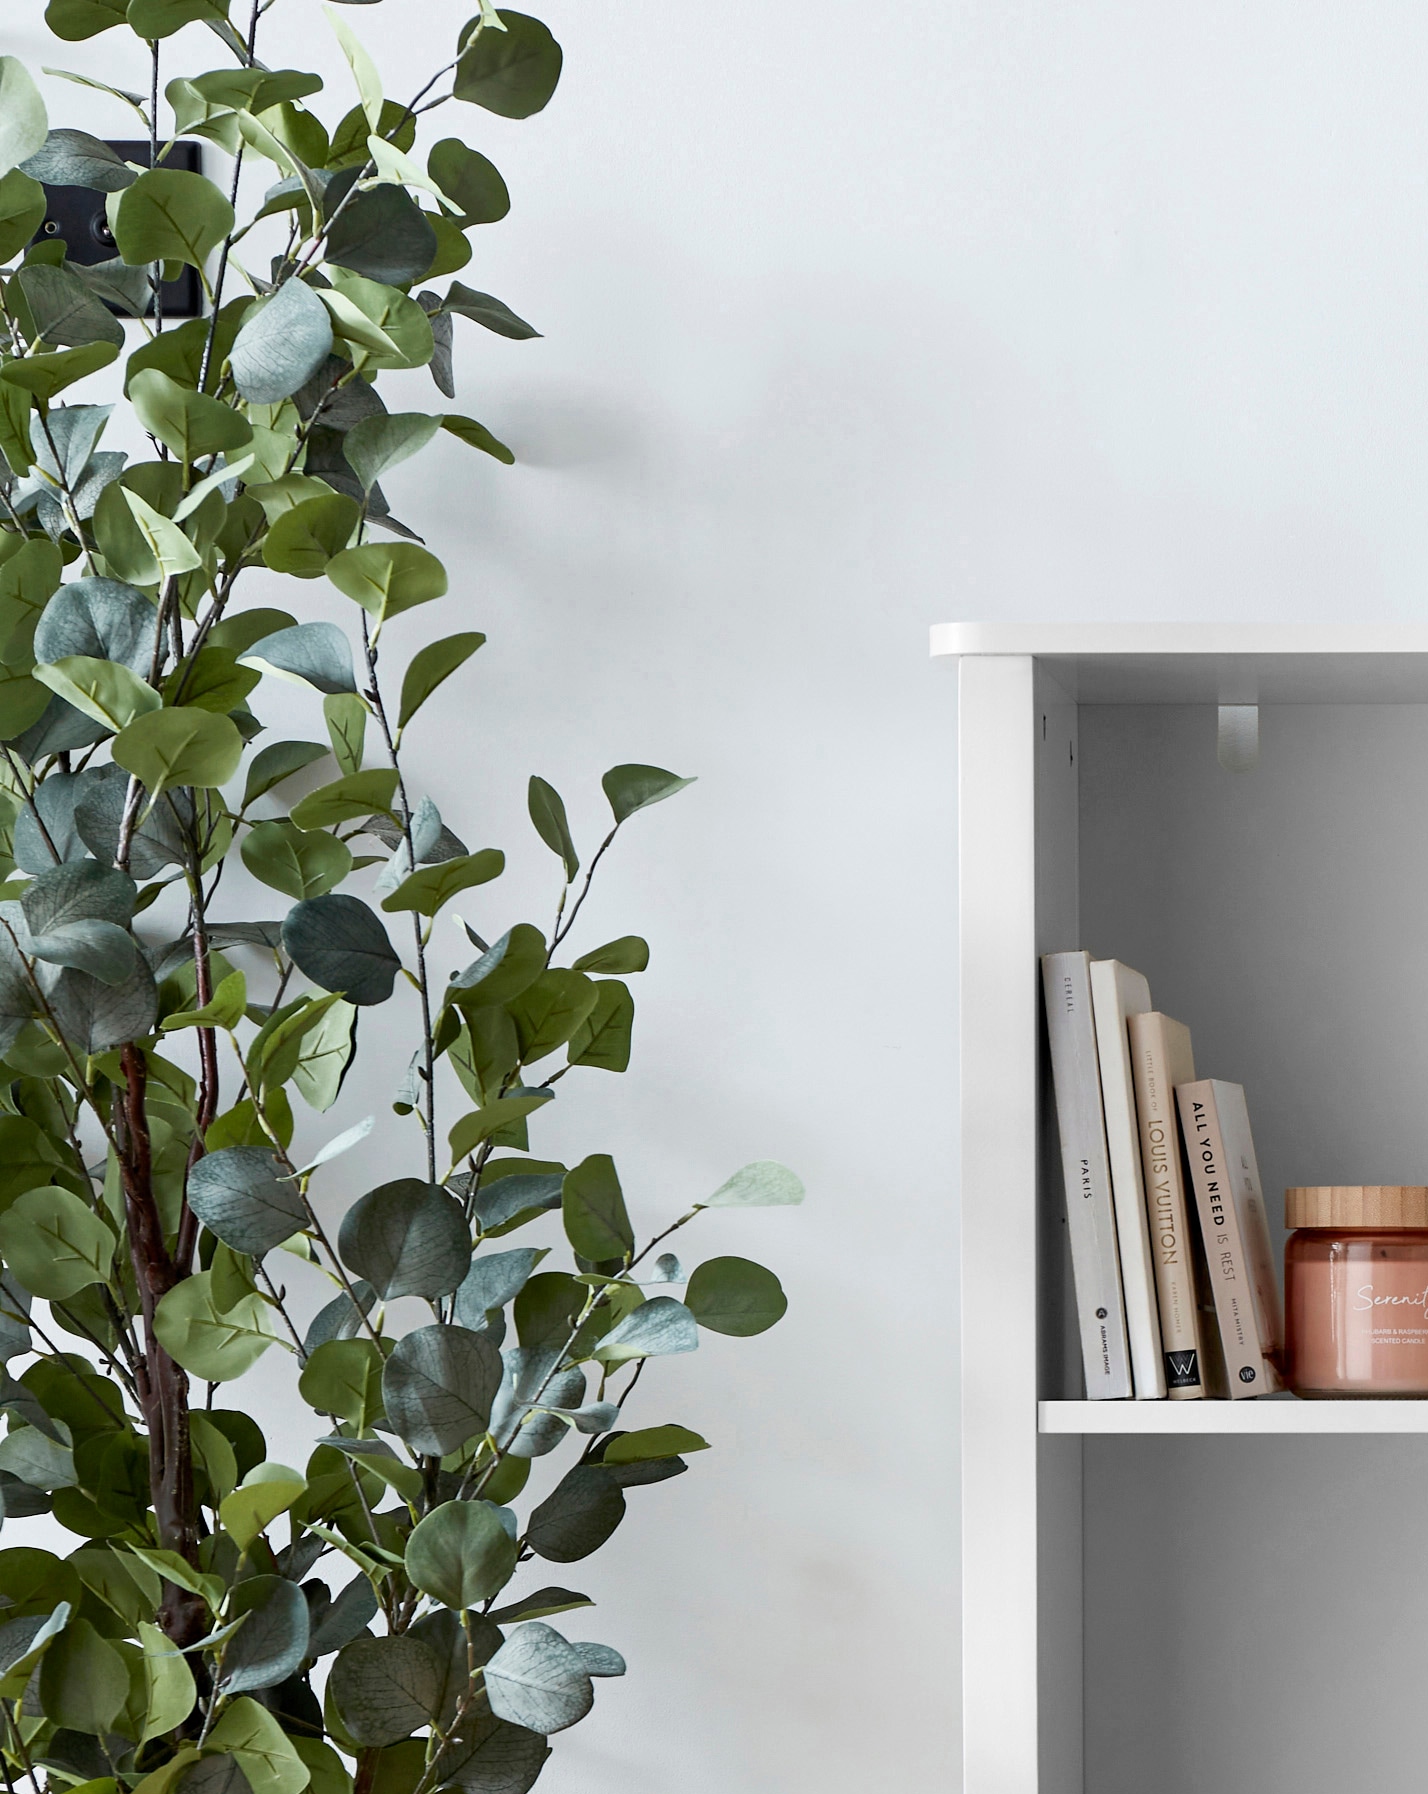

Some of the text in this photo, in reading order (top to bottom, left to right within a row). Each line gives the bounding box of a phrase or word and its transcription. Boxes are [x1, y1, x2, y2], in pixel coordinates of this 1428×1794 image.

[1064, 977, 1074, 1013] CEREAL
[1145, 1050, 1154, 1075] LITTLE
[1148, 1077, 1156, 1099] BOOK
[1080, 1159, 1092, 1199] PARIS
[1148, 1119, 1178, 1265] LOUIS VUITTON
[1192, 1102, 1236, 1282] ALL YOU NEED IS REST
[1100, 1325, 1111, 1375] ABRAMS IMAGE
